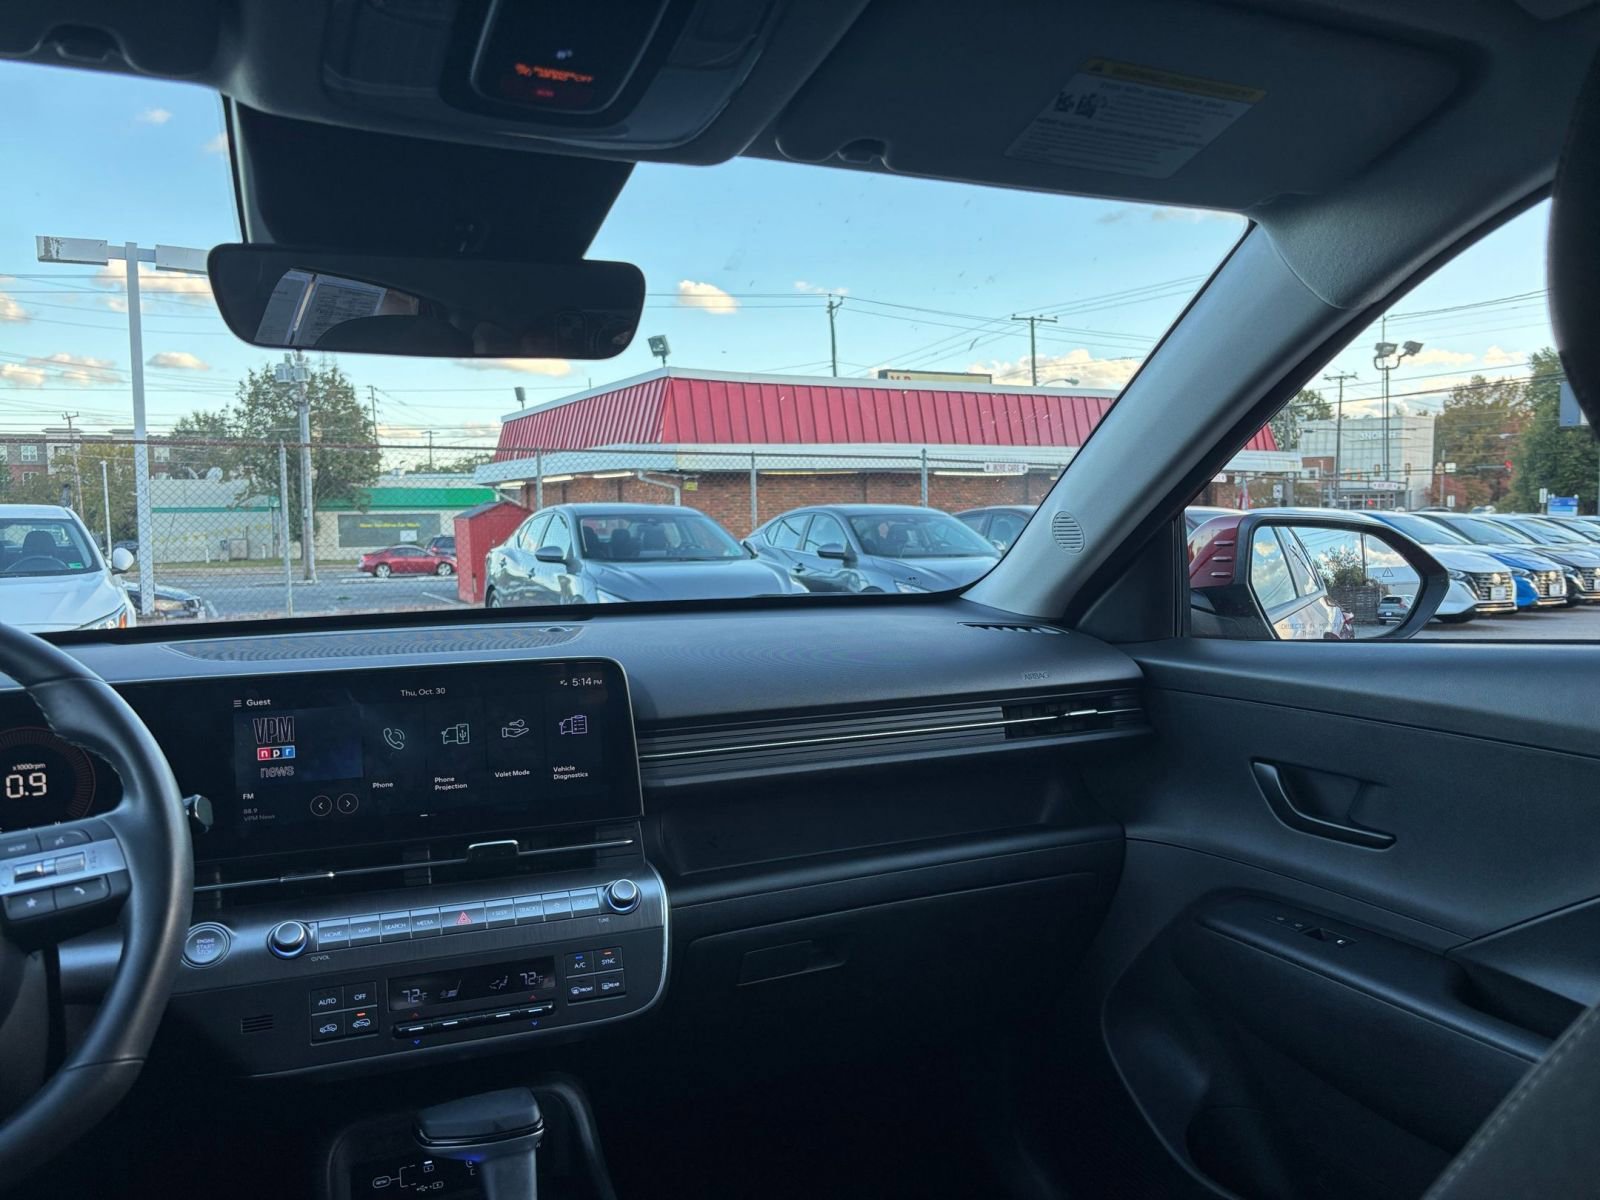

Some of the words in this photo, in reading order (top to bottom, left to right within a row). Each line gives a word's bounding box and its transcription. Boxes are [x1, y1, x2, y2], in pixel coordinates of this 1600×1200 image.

[572, 677, 592, 687] 5:14
[400, 689, 418, 697] Thu,
[418, 688, 434, 696] Oct.
[435, 687, 446, 695] 30
[246, 699, 271, 707] Guest
[252, 715, 295, 745] VPM
[260, 765, 295, 779] news
[512, 769, 530, 777] Mode
[553, 765, 576, 773] Vehicle
[553, 772, 589, 780] Diagnostics
[5, 772, 47, 799] 0.9
[434, 783, 468, 791] Projection
[242, 792, 255, 800] FM
[416, 919, 434, 927] MEDIA
[601, 957, 616, 965] SYNC
[354, 993, 367, 1001] OFF
[318, 997, 337, 1006] AUTO
